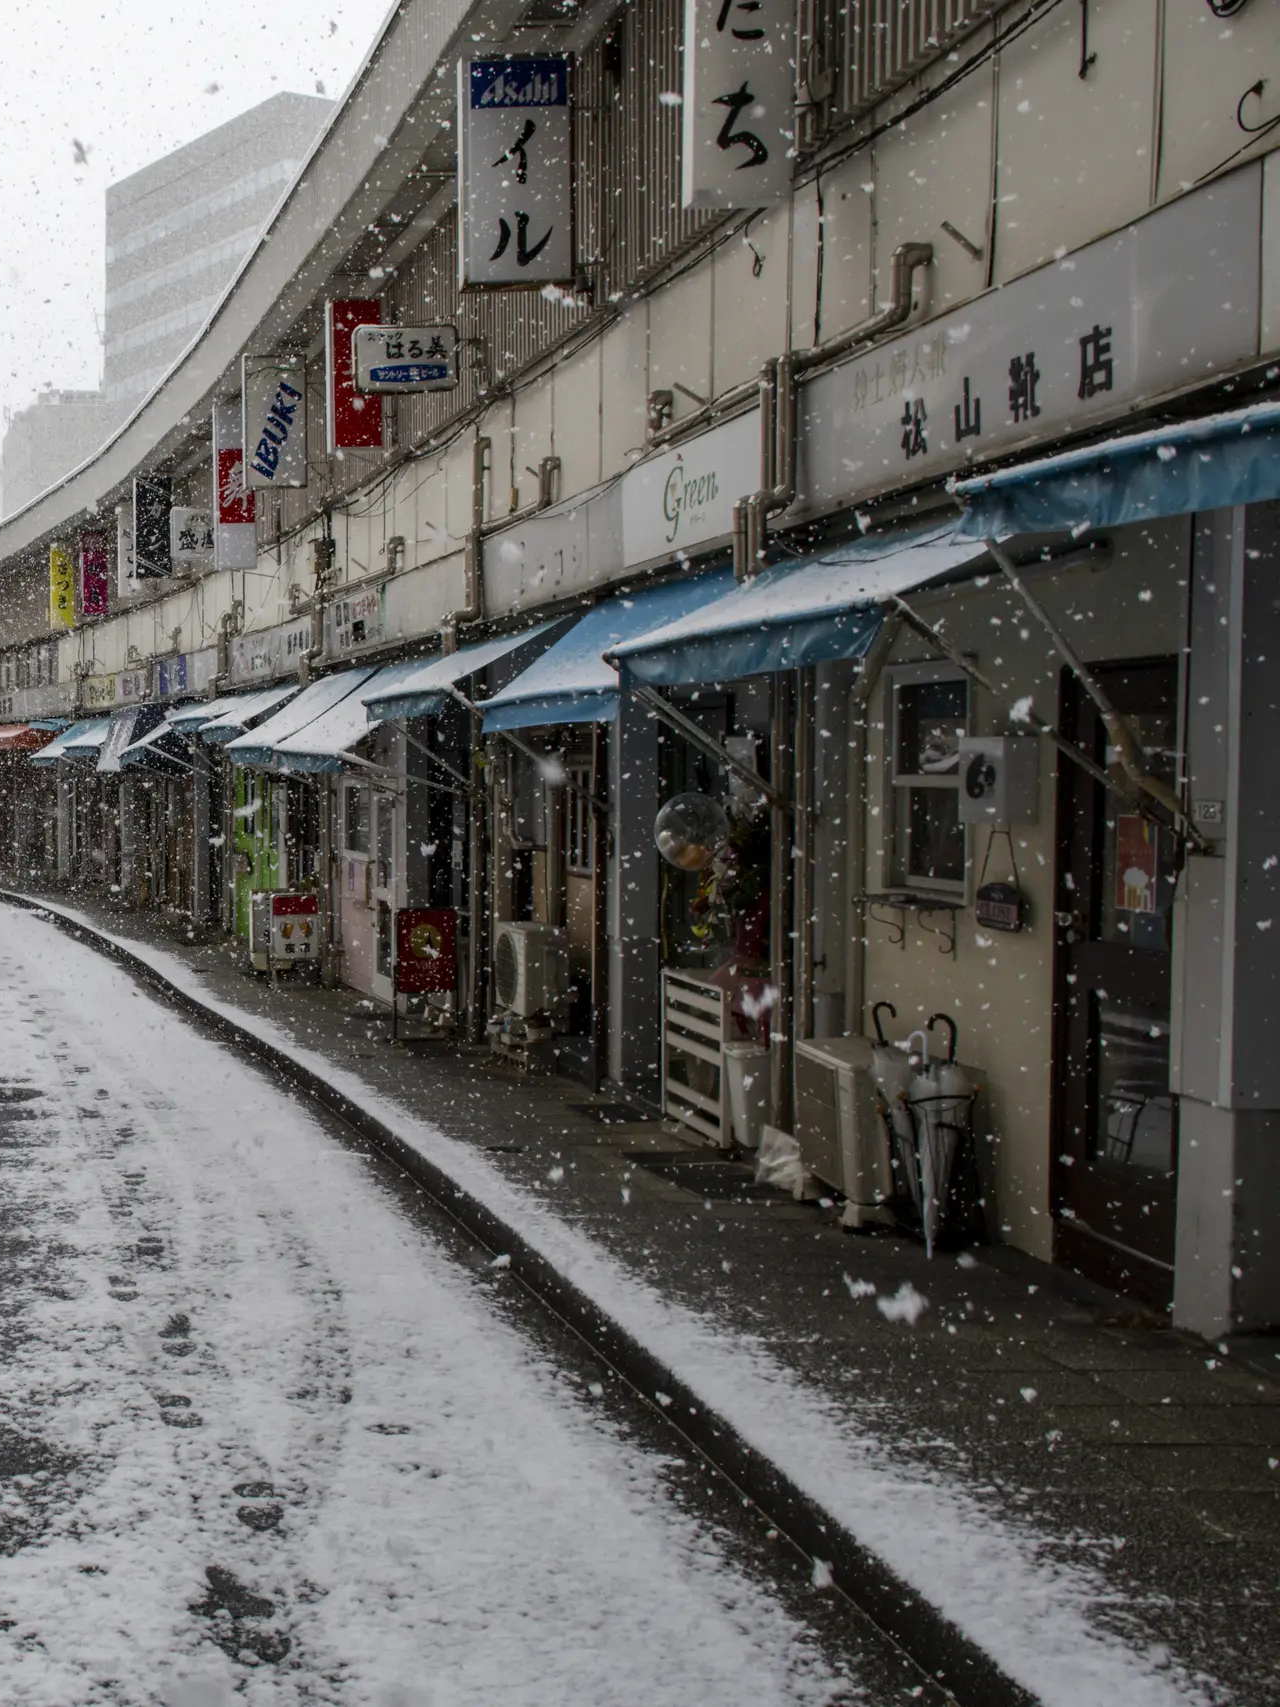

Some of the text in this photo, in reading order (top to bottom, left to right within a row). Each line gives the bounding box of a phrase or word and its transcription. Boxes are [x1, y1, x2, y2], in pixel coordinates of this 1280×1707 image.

[480, 72, 559, 105] Asahi
[489, 119, 554, 267] イル
[386, 335, 448, 360] はる美
[900, 324, 1114, 460] 松山靴店
[251, 381, 303, 480] IBUKI
